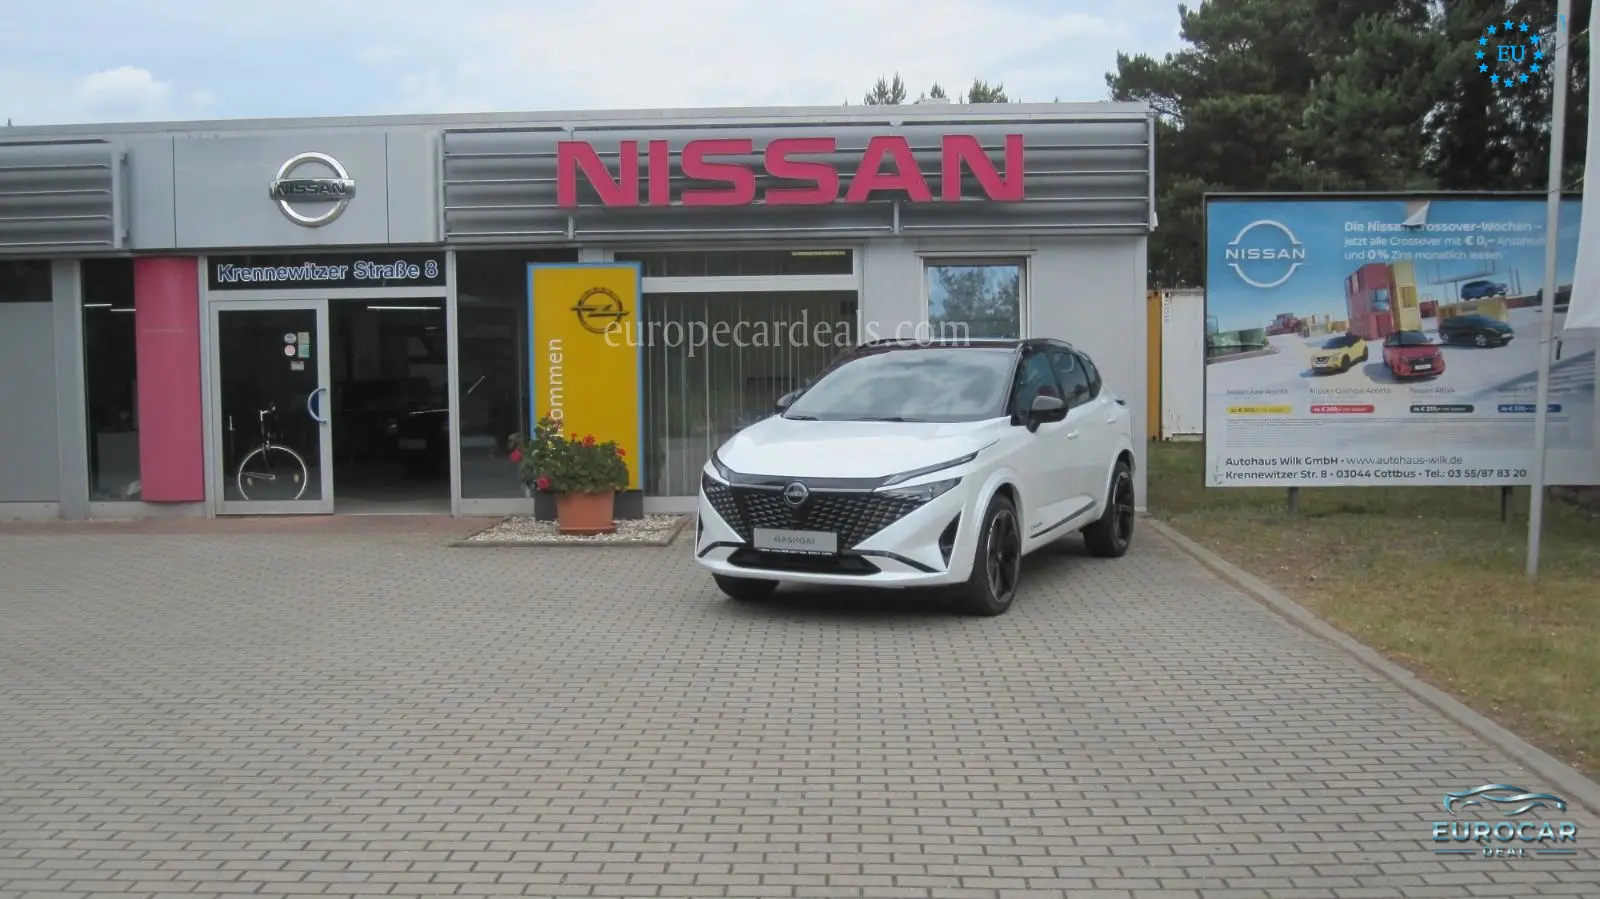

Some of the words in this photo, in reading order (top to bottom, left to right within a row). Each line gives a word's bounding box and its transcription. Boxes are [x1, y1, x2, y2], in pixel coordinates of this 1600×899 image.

[557, 133, 1025, 208] NISSAN
[274, 181, 346, 196] NISSAN
[1344, 221, 1365, 232] Die
[1412, 221, 1532, 232] rossover-Wochen
[1370, 236, 1388, 246] alle
[1390, 237, 1441, 246] Crossover
[1445, 236, 1462, 246] mit
[1496, 236, 1548, 247] Anzahlun
[1225, 248, 1306, 260] NISSAN
[1344, 250, 1365, 260] und
[1391, 250, 1413, 260] Zins
[217, 264, 348, 282] Krennewitzer
[353, 260, 420, 279] Straße
[424, 259, 439, 278] 8
[1225, 457, 1277, 466] Autohaus
[1280, 456, 1302, 466] Wilk
[1304, 456, 1338, 465] GmbH
[1225, 470, 1298, 480] Krennewitzer
[1300, 470, 1318, 479] Str.
[1320, 470, 1327, 479] 8
[1336, 469, 1371, 479] 03044
[1374, 469, 1416, 478] Cottbus
[1463, 468, 1494, 478] 55/87
[1496, 469, 1510, 478] 83
[1512, 468, 1527, 478] 20
